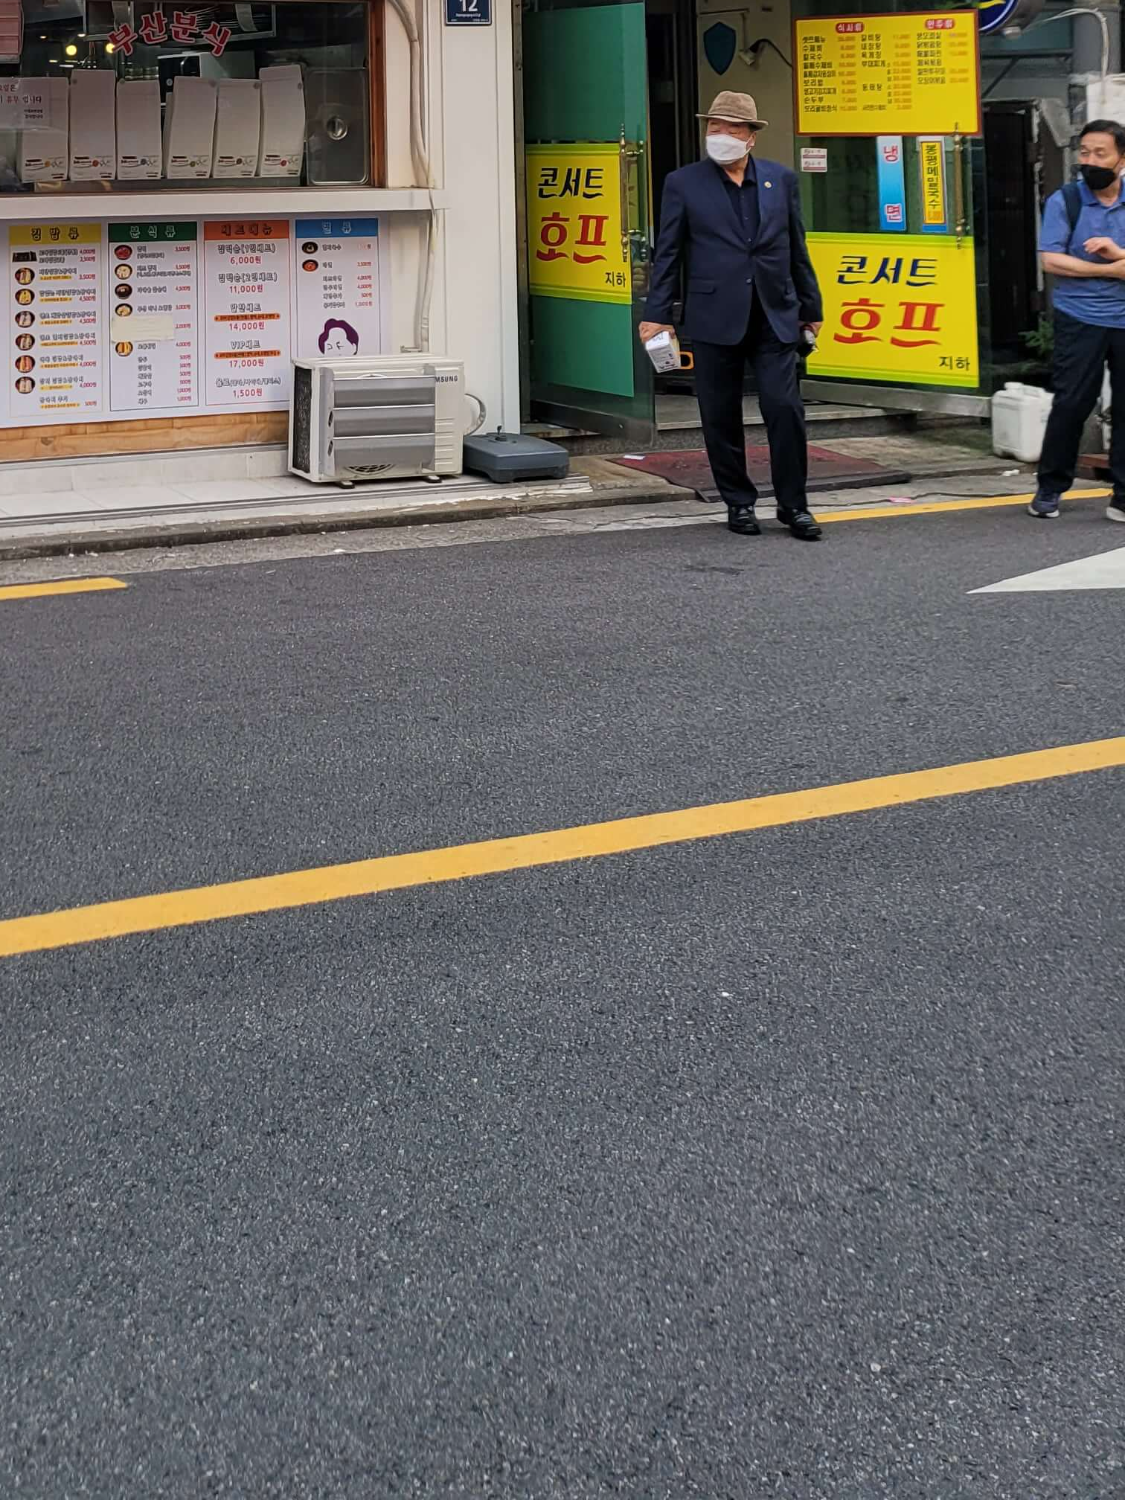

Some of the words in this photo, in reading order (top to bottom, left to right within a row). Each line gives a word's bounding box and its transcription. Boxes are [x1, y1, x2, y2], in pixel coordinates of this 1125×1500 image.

[107, 10, 233, 57] 부산분식
[537, 166, 605, 199] 콘서트
[536, 210, 610, 264] 호프
[230, 256, 262, 265] 6,000원
[836, 255, 940, 287] 콘서트
[604, 271, 627, 289] 지하
[229, 284, 263, 294] 11,000원
[229, 321, 265, 331] 14,000원
[833, 297, 946, 348] 호프
[229, 359, 265, 369] 17,000원
[938, 355, 972, 372] 지하
[232, 388, 263, 398] 1,500원
